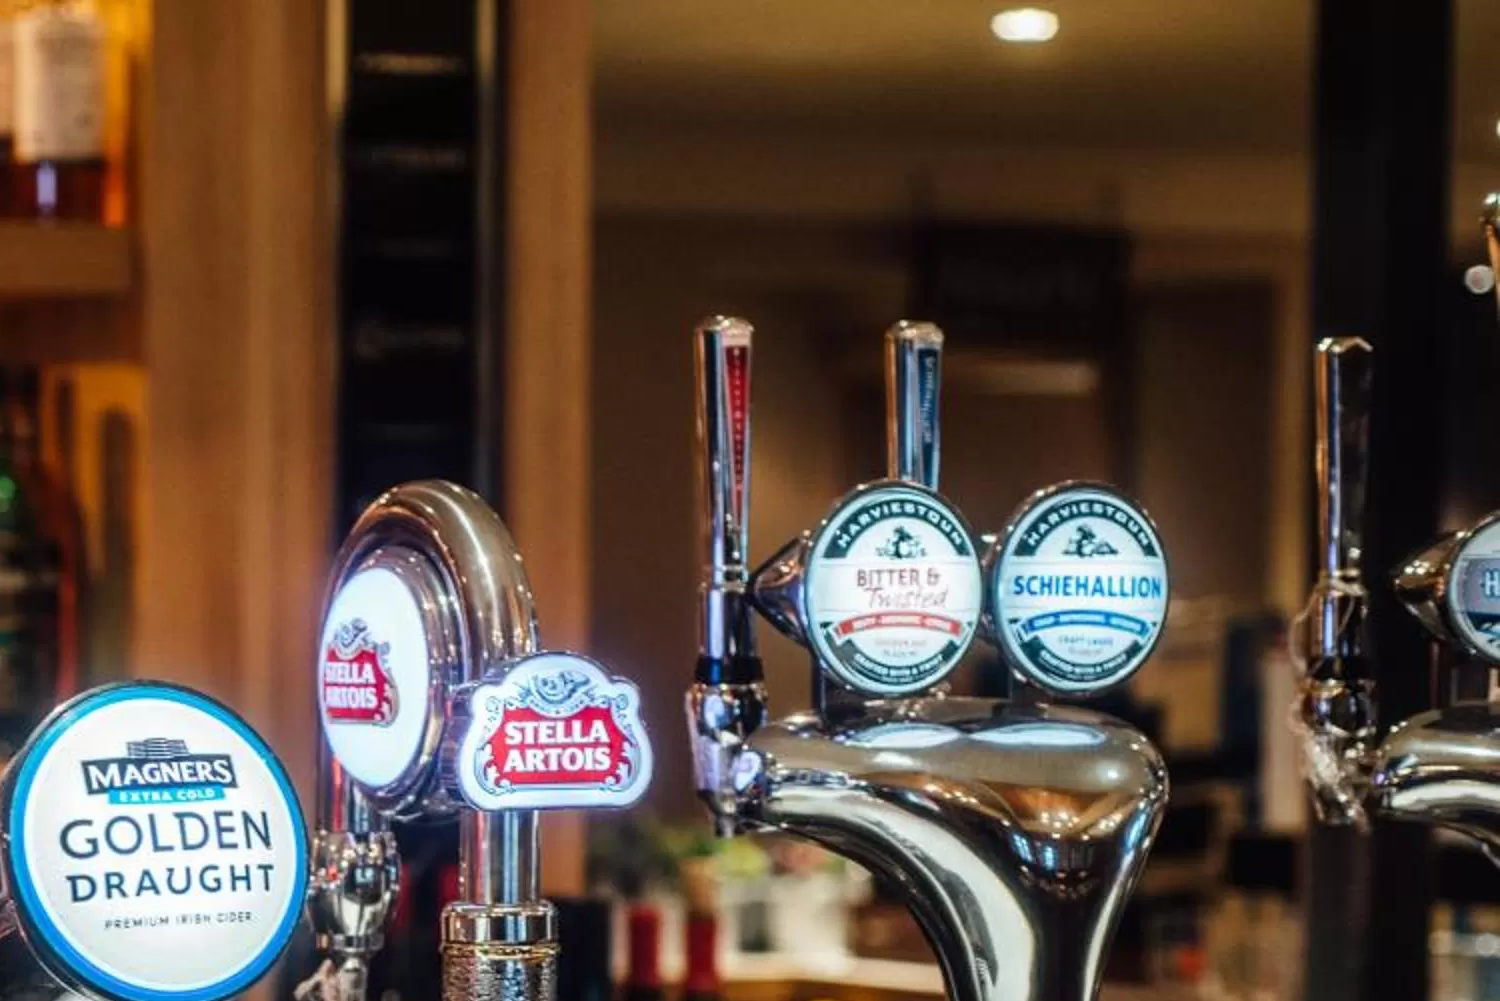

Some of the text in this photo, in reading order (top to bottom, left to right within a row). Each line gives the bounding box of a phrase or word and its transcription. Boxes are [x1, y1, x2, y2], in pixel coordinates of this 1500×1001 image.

[836, 502, 964, 549] HARVIESTOUN
[1027, 502, 1152, 547] HARVIESTOUN
[857, 568, 942, 587] BITTER &
[1012, 575, 1162, 598] SCHIEHALLION
[325, 662, 375, 684] STELLA
[325, 687, 377, 709] ARTOIS
[504, 719, 610, 745] STELLA
[503, 747, 611, 773] ARTOIS
[87, 759, 232, 792] MAGNERS
[119, 788, 216, 803] EXTRA COLD
[60, 810, 272, 859] GOLDEN
[66, 864, 274, 903] DRAUGHT
[104, 910, 252, 929] PREMIUM IRISH CIDER
